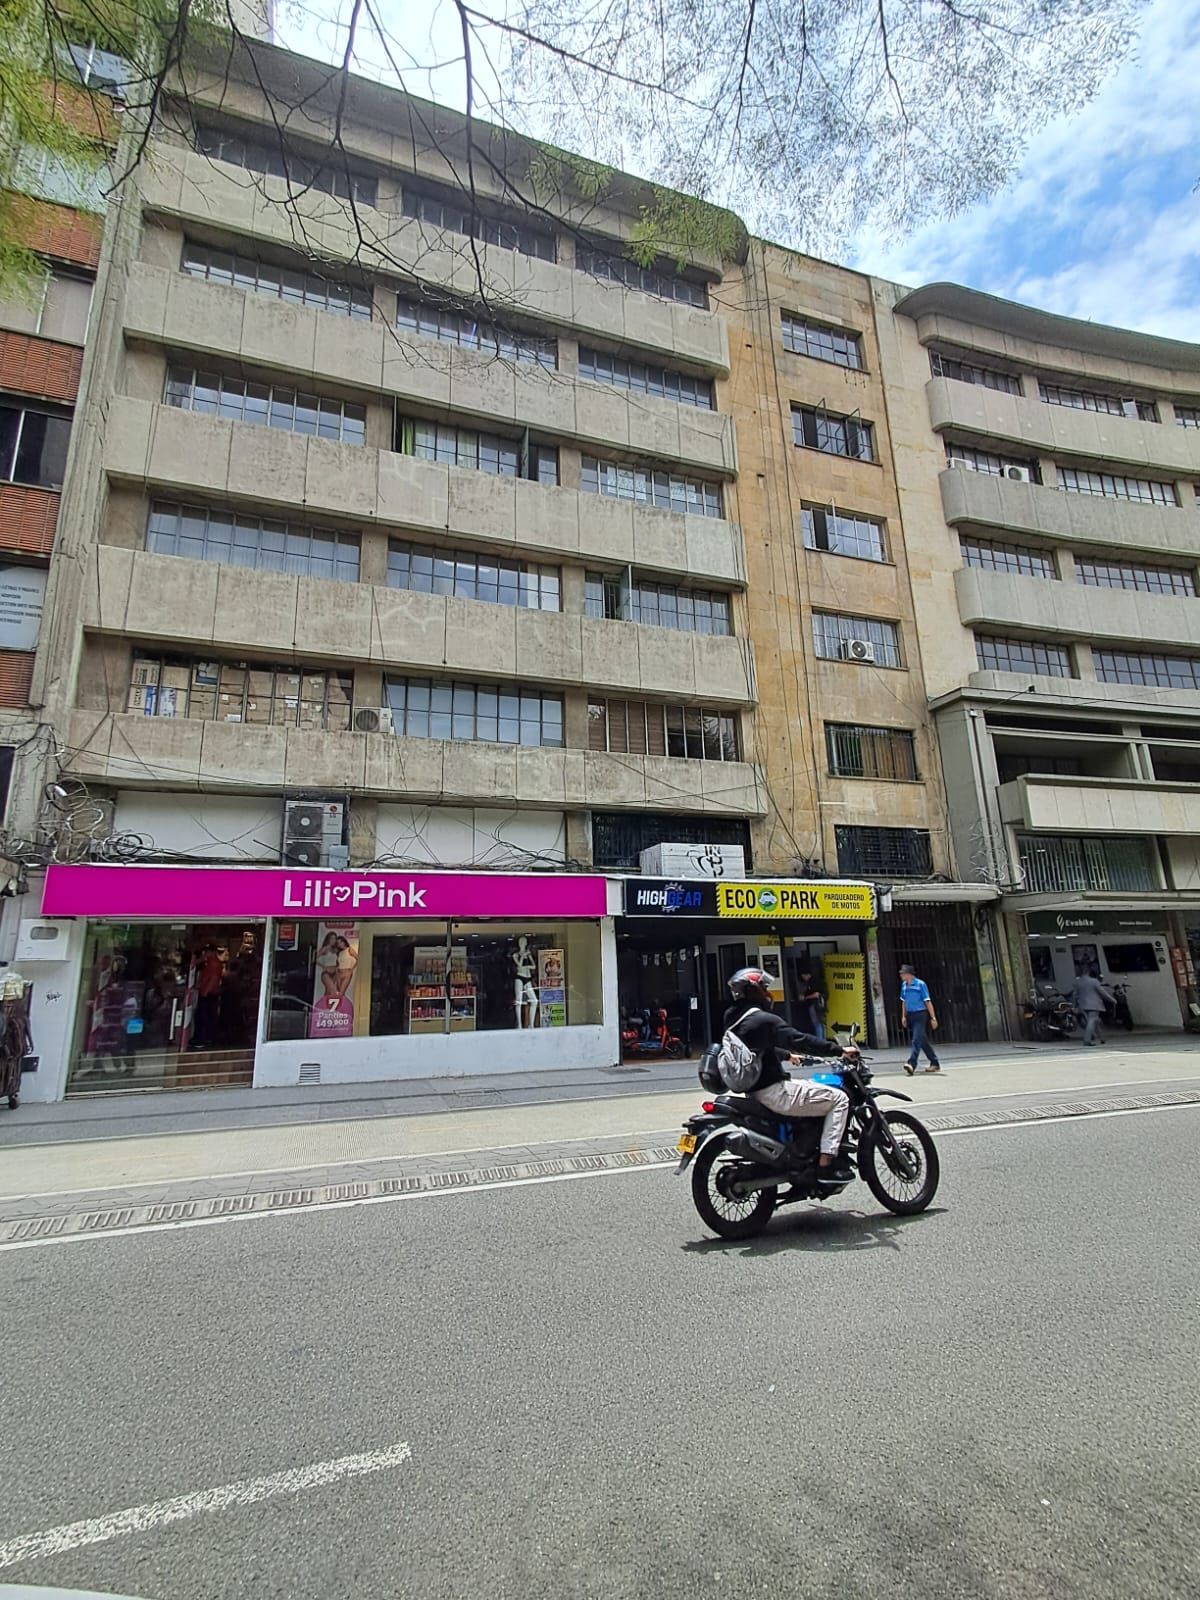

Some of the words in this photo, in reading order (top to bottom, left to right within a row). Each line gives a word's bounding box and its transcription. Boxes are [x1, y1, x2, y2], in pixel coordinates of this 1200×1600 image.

[283, 879, 332, 907] Lili
[352, 880, 428, 908] Pink
[725, 889, 756, 909] ECO
[780, 890, 820, 910] PARK
[824, 893, 865, 902] PARQUEADERO
[841, 902, 860, 910] MOTOS
[328, 998, 340, 1013] 7
